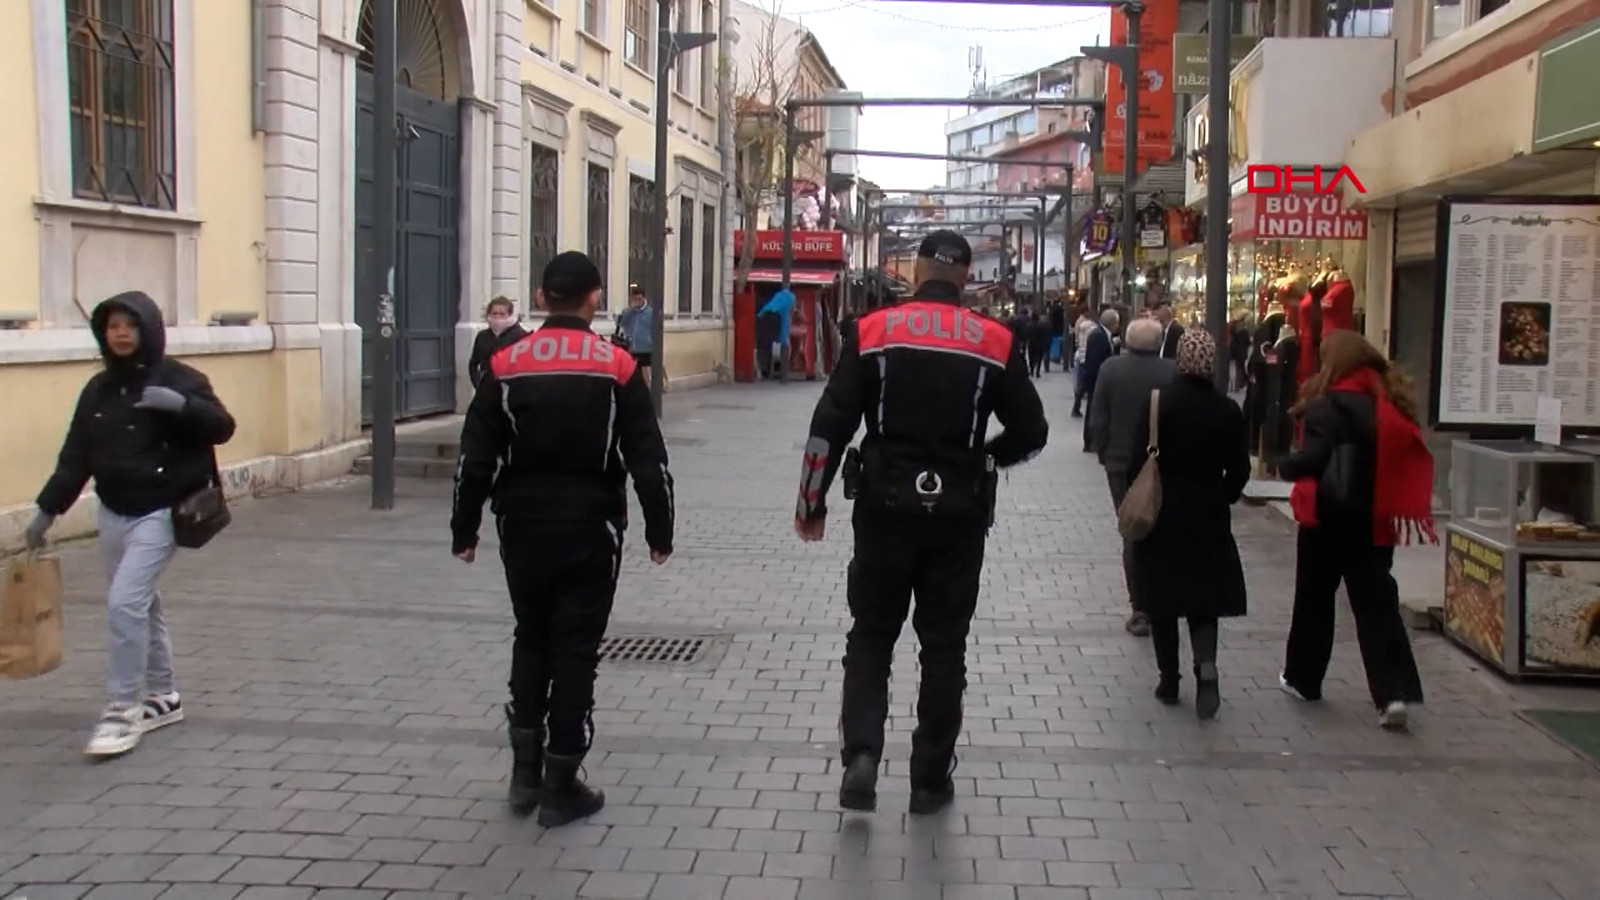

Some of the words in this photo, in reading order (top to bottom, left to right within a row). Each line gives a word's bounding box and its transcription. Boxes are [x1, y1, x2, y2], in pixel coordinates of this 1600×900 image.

[1092, 224, 1108, 241] 10
[1259, 214, 1363, 237] İNDİRİM
[762, 240, 802, 251] KÜLR
[804, 240, 833, 252] BÜFE
[885, 307, 983, 344] POLİS
[510, 335, 614, 364] POLİS
